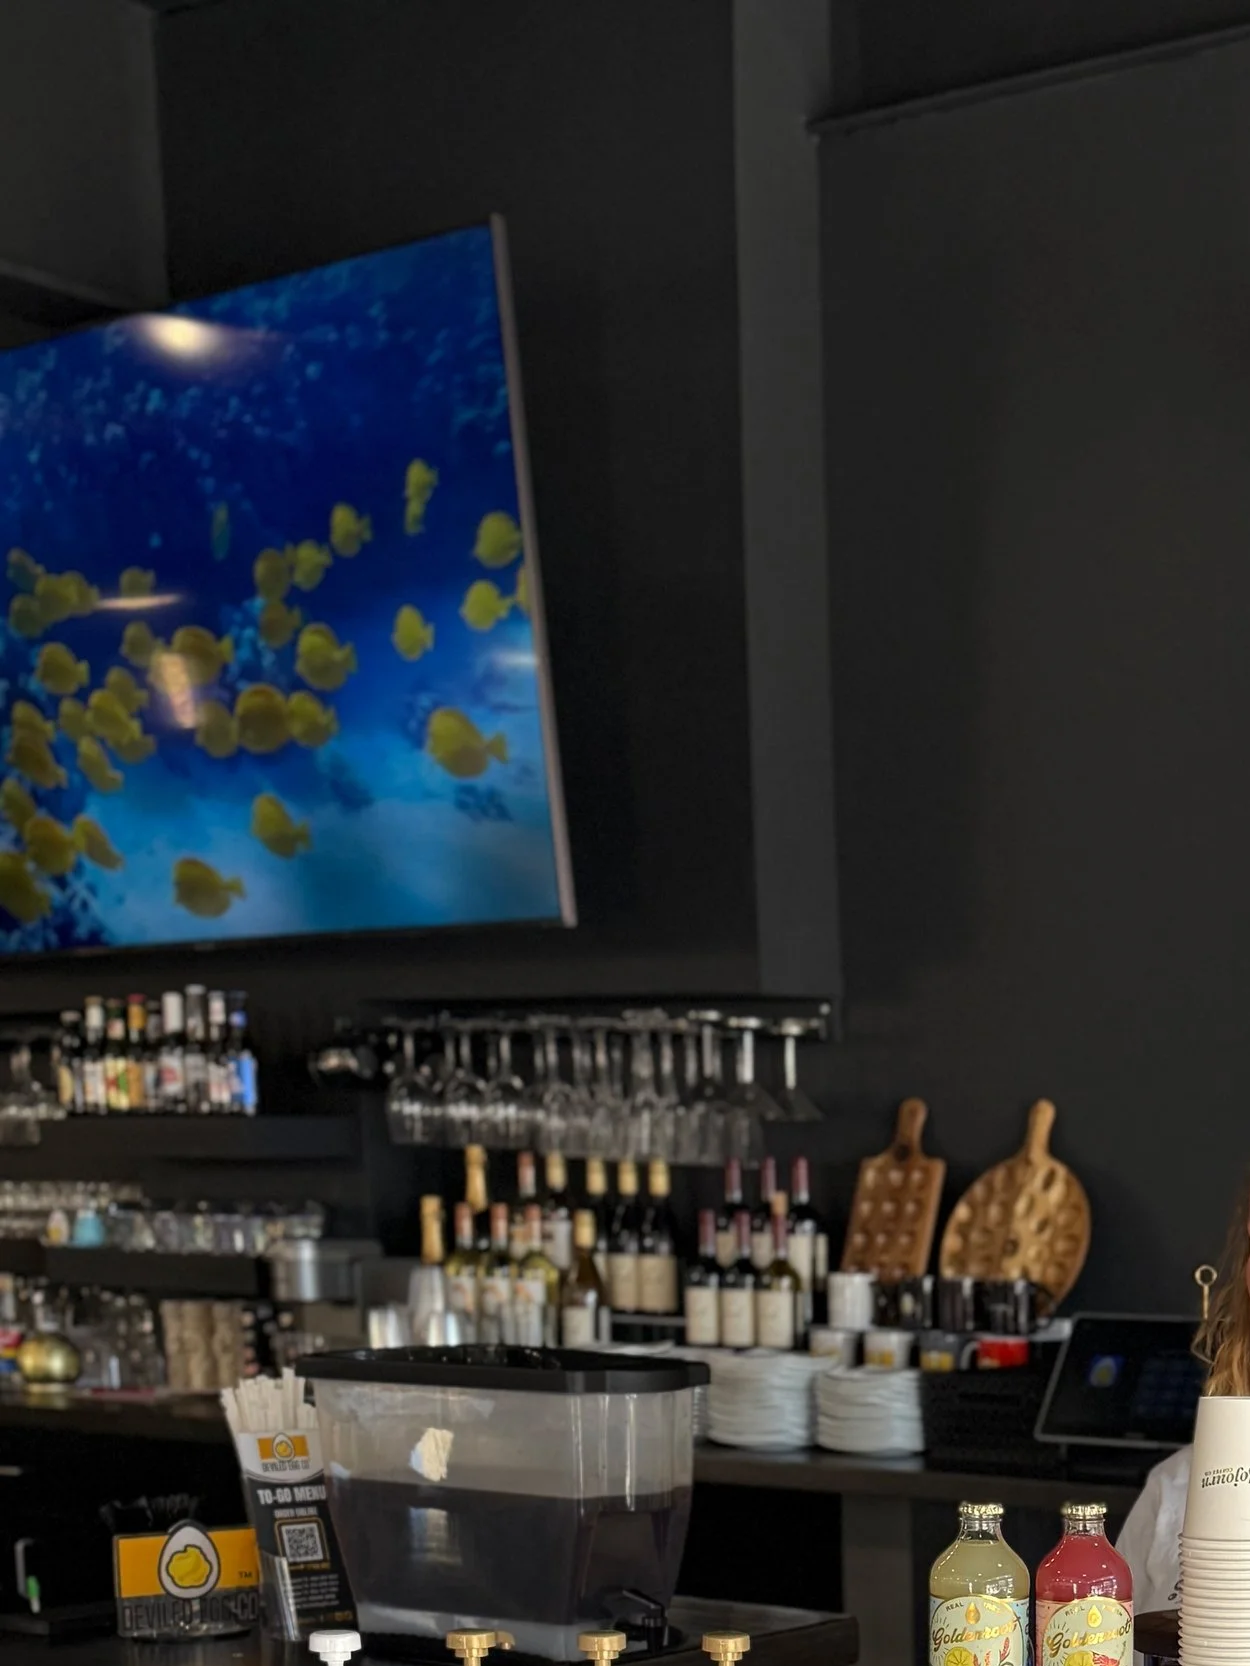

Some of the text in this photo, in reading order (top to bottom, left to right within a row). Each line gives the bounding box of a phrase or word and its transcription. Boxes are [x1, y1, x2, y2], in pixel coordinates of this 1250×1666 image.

[257, 1485, 326, 1504] TO-GO MENU
[945, 1601, 965, 1612] REAL
